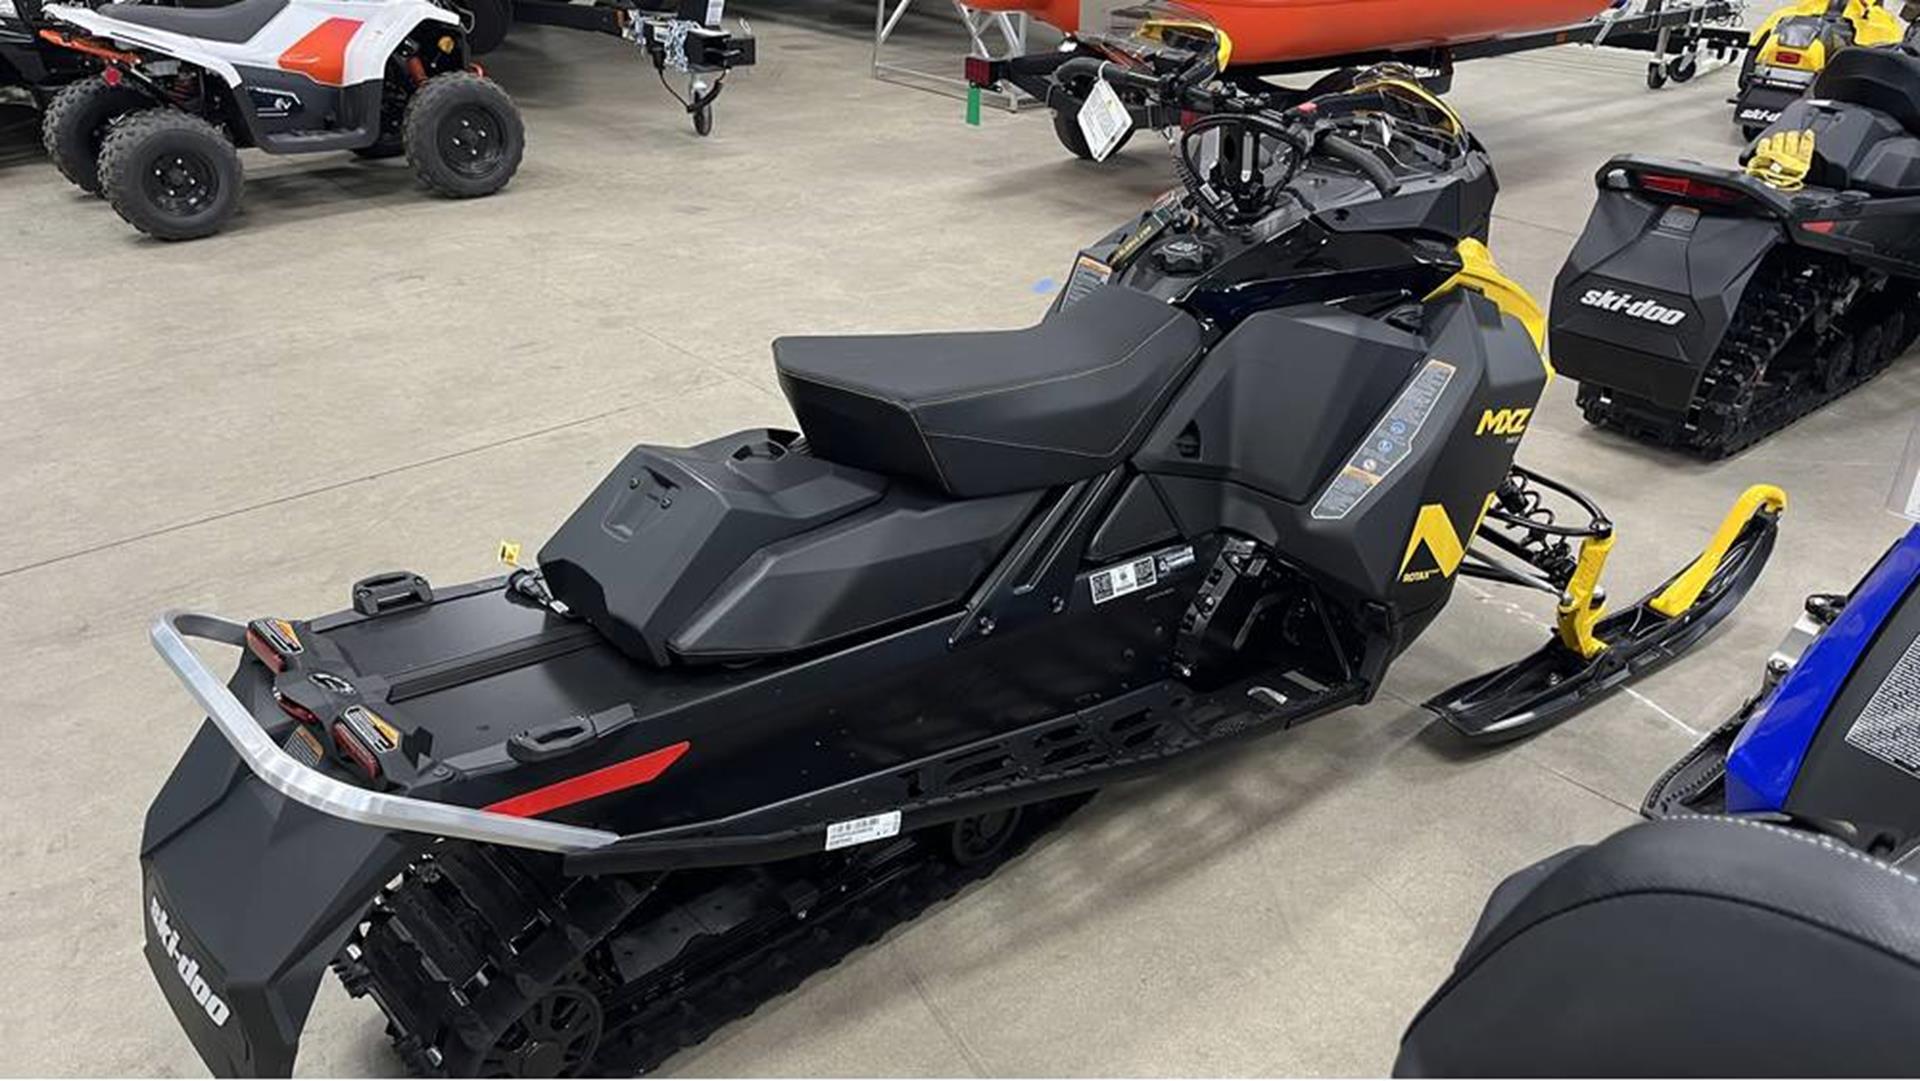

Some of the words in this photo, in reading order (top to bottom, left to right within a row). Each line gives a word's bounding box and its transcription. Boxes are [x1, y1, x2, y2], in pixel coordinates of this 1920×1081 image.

[1740, 109, 1782, 122] ski-d
[1580, 289, 1686, 325] ski-doo
[1474, 408, 1532, 436] MXZ
[151, 895, 231, 1027] ski-doo
